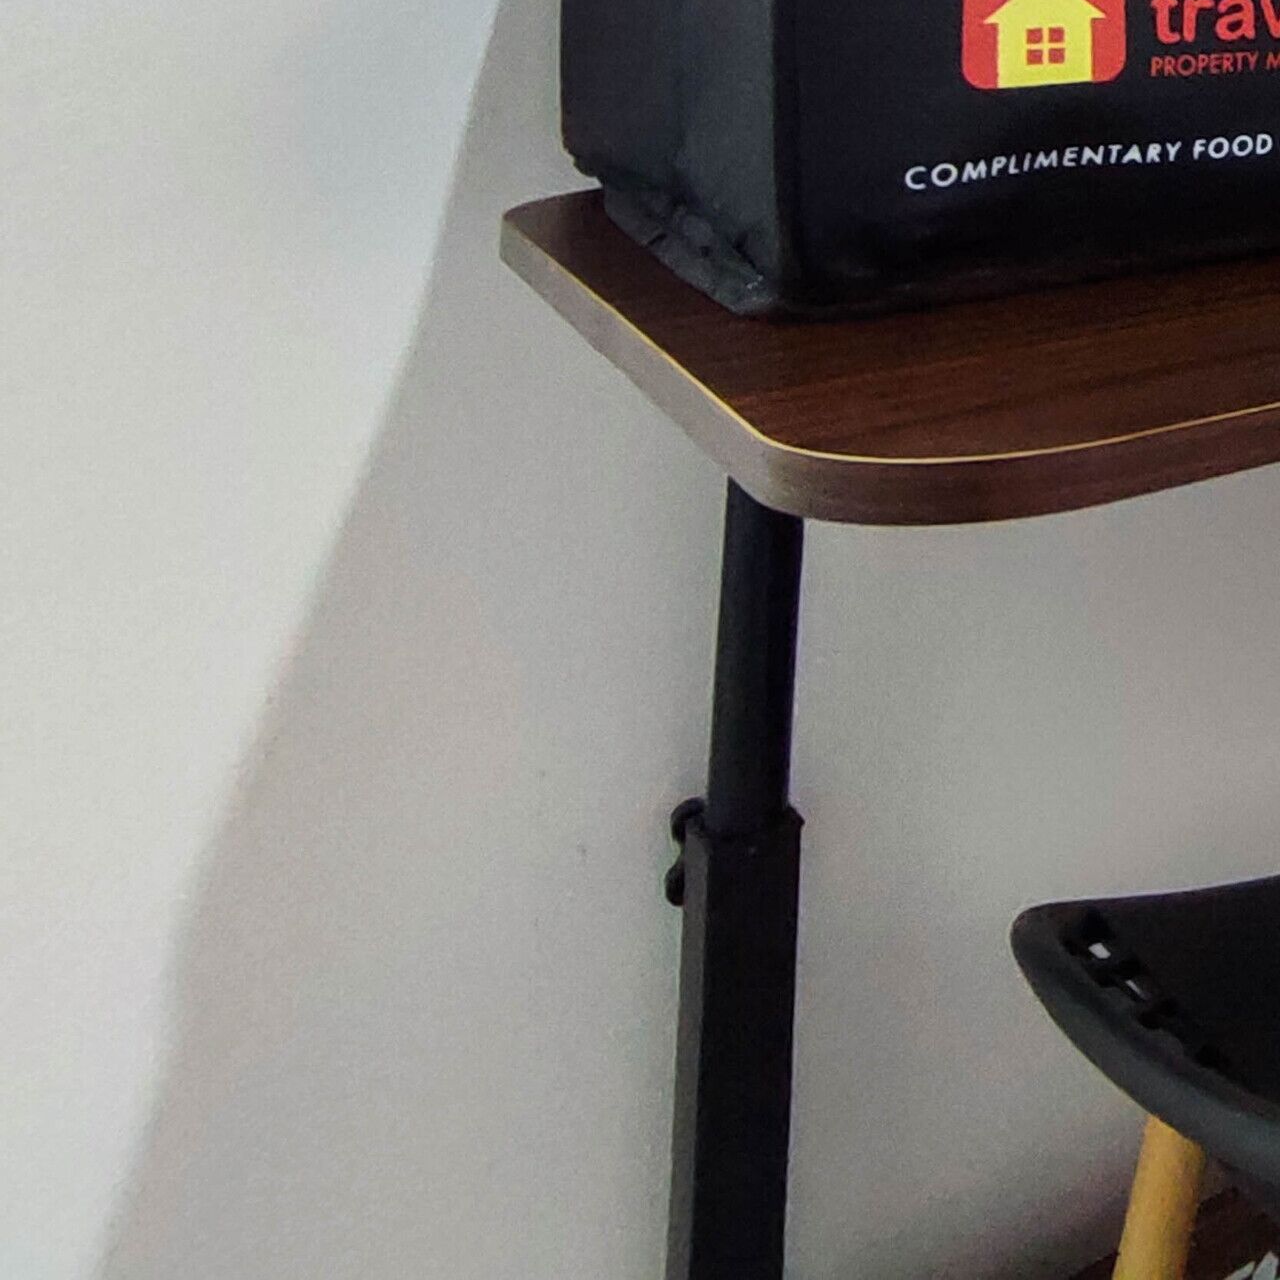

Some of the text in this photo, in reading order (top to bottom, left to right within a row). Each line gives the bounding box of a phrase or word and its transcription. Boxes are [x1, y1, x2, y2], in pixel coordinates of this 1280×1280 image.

[1150, 49, 1259, 78] PROPERTY
[903, 140, 1183, 191] COMPLIMENTARY
[1192, 133, 1274, 161] FOOD
